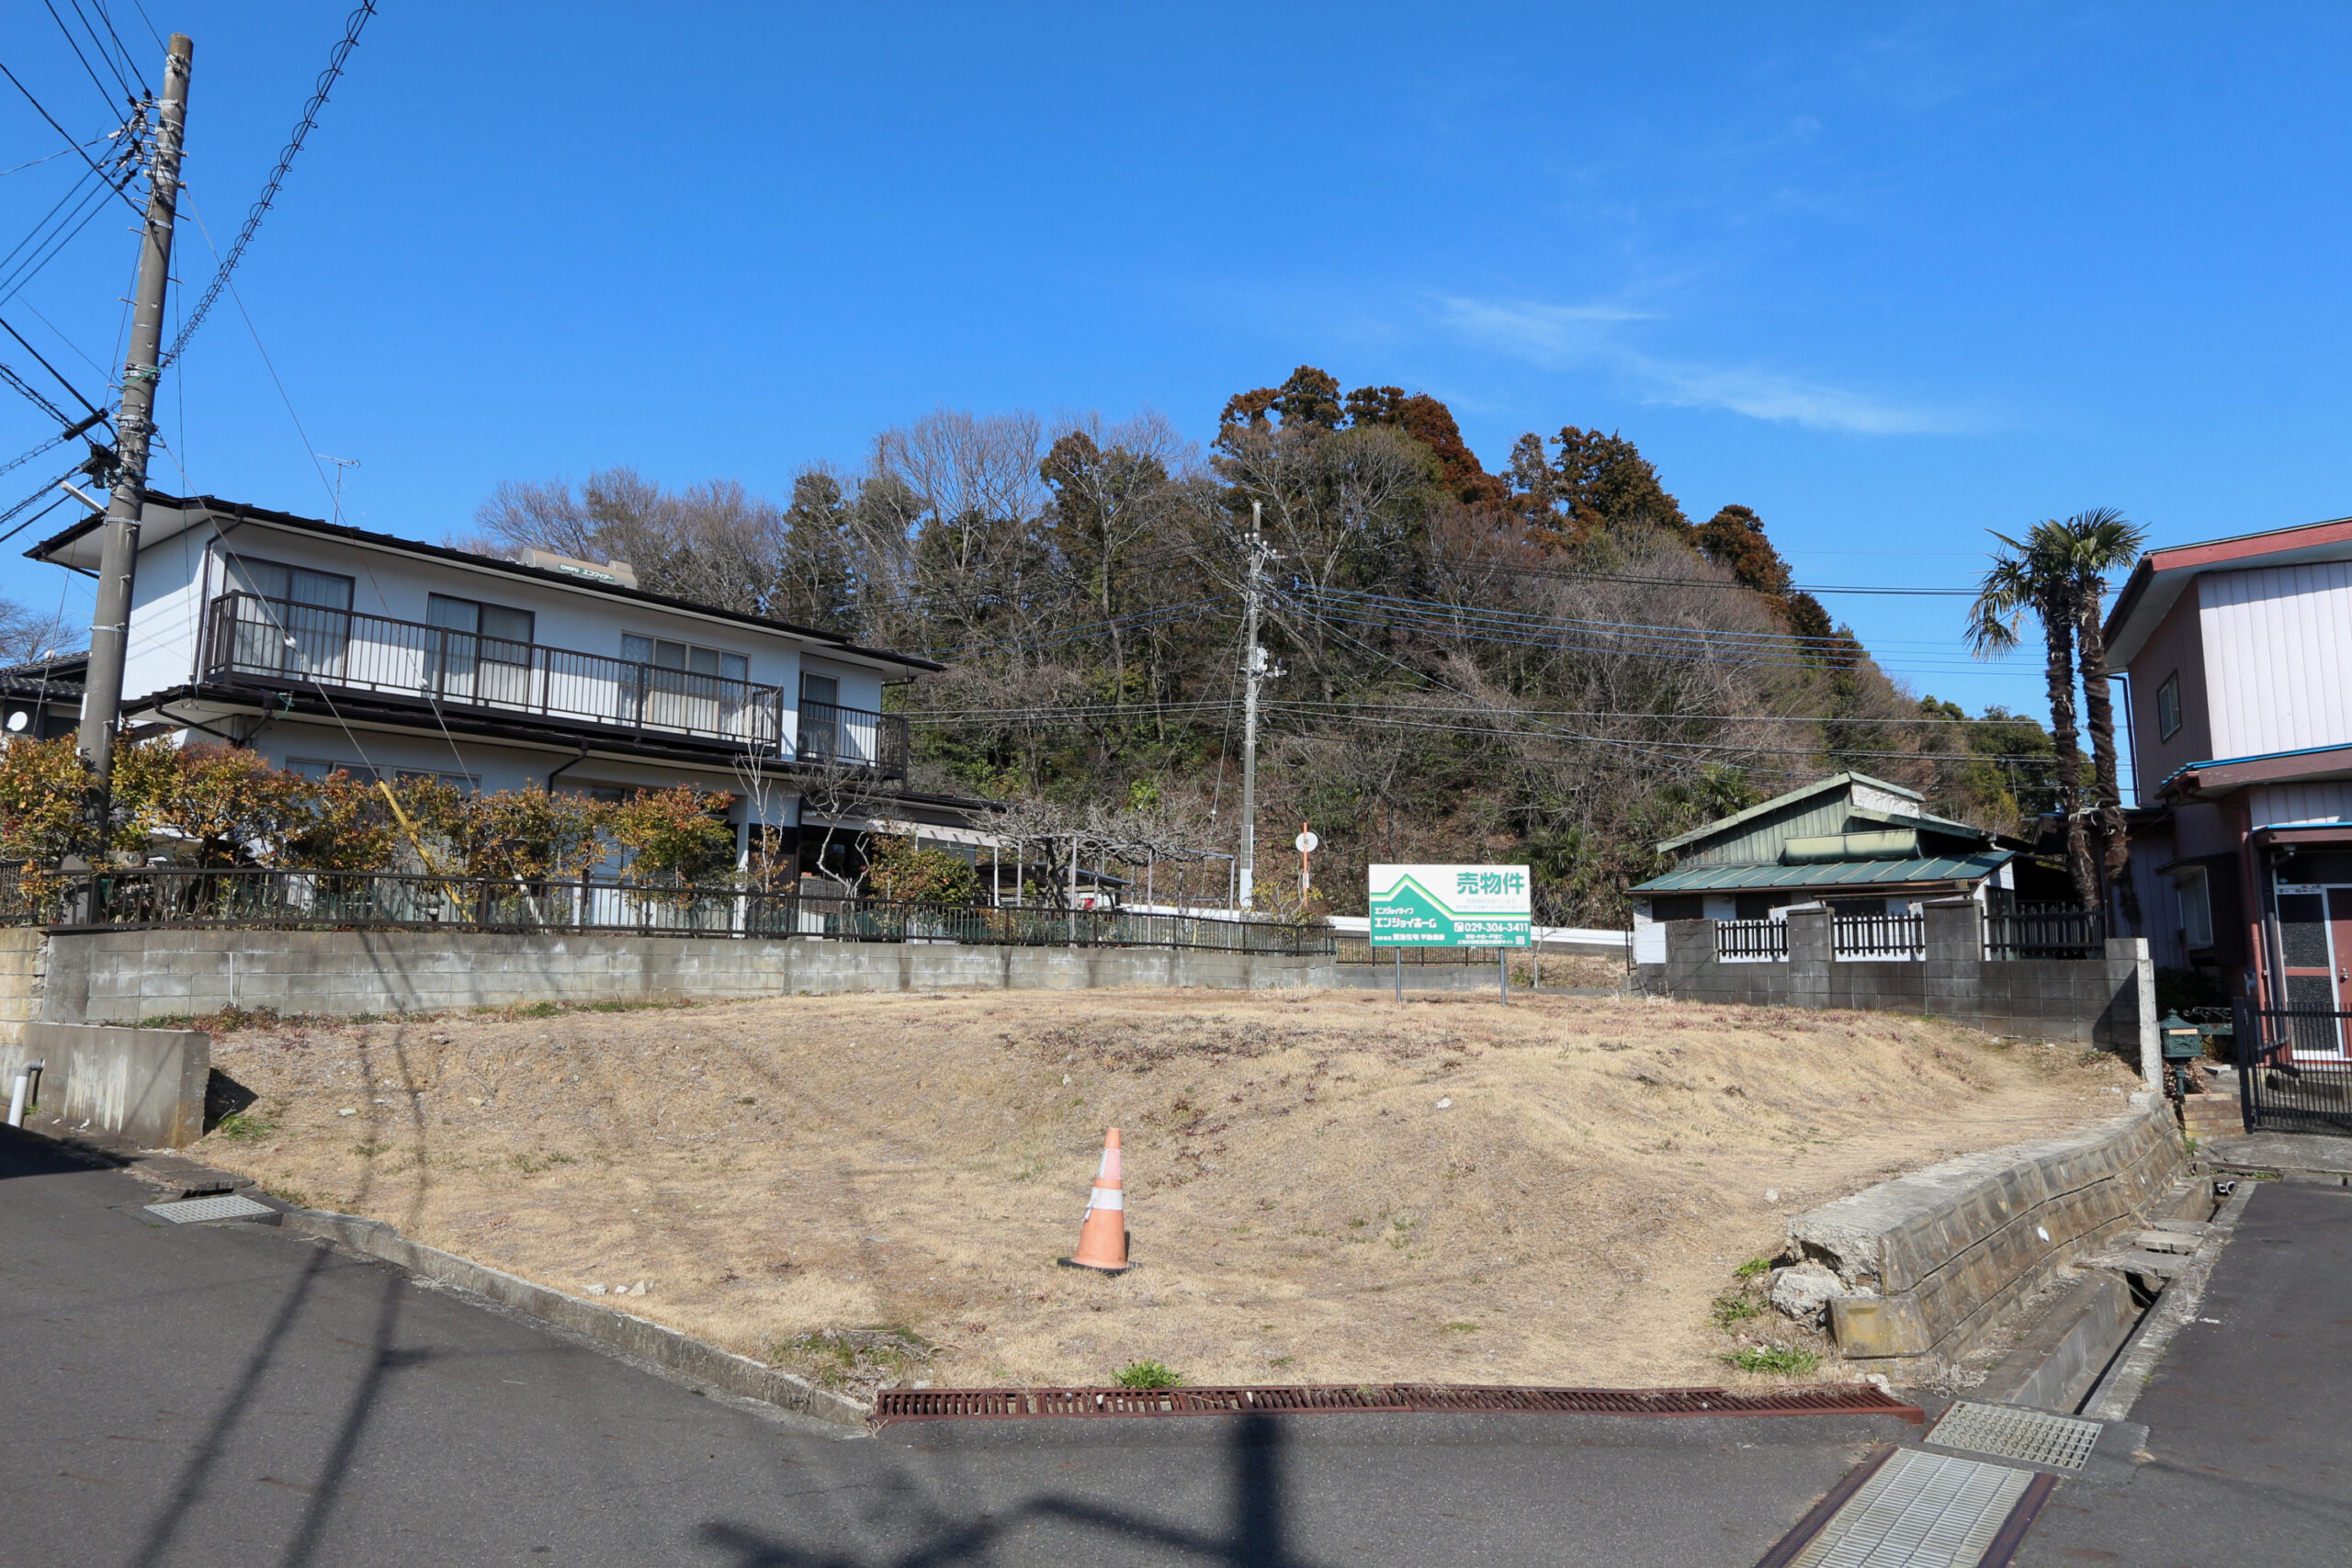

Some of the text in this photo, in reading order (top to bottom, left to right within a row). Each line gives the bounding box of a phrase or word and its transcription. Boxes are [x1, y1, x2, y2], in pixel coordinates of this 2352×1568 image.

[560, 564, 580, 573] CHOFU
[1457, 872, 1525, 895] 売物件
[1374, 907, 1414, 915] エンジョイライフ
[1374, 916, 1438, 929] エンジョイホーム
[1464, 922, 1529, 932] 029-306-3411
